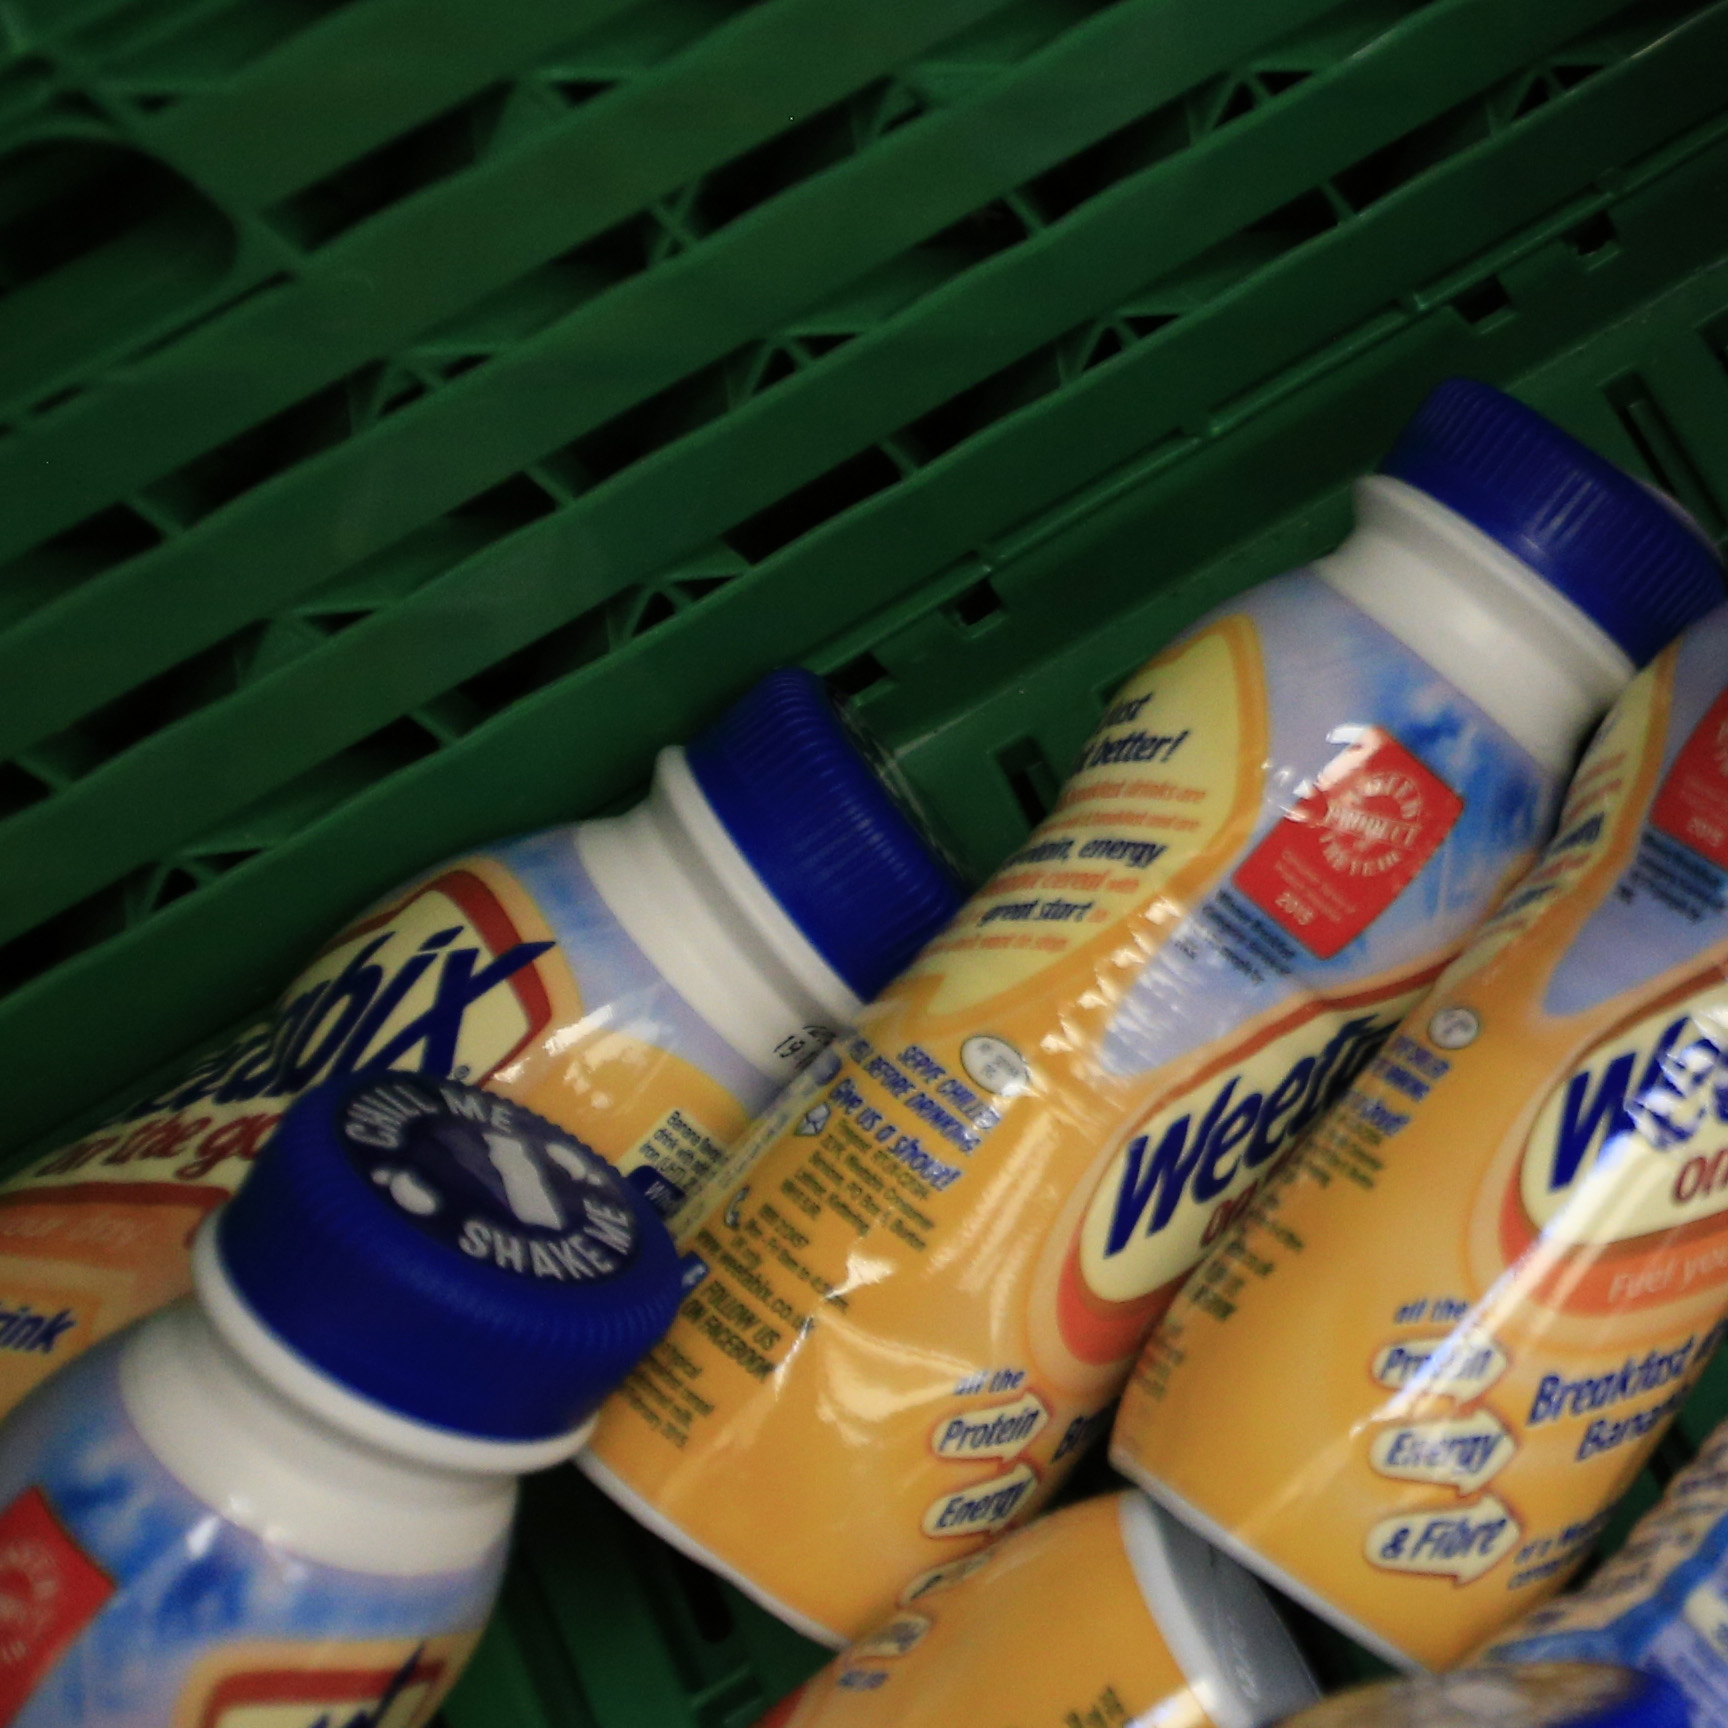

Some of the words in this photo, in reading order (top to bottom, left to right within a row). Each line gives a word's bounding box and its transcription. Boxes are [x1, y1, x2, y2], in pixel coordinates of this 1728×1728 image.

[1077, 832, 1169, 873] energy
[976, 900, 1040, 927] great
[1038, 895, 1095, 925] start
[862, 1052, 917, 1104] BEFORE
[895, 1041, 945, 1087] SERVE
[344, 1085, 439, 1150] CHILL
[439, 1087, 512, 1134] ME
[827, 1075, 870, 1118] Give
[853, 1104, 884, 1135] us
[873, 1120, 898, 1146] a
[886, 1125, 963, 1196] shout!
[457, 1218, 615, 1282] SHAKE
[582, 1198, 632, 1255] ME
[699, 1278, 761, 1335] FOLLOW
[750, 1321, 783, 1353] US
[697, 1313, 776, 1384] FACEBOOK
[987, 1366, 1026, 1394] the
[942, 1396, 1043, 1454] Protein
[1379, 1408, 1511, 1492] Energy
[934, 1473, 1039, 1532] Energy
[1376, 1525, 1415, 1561] &
[1407, 1503, 1514, 1571] Fibre
